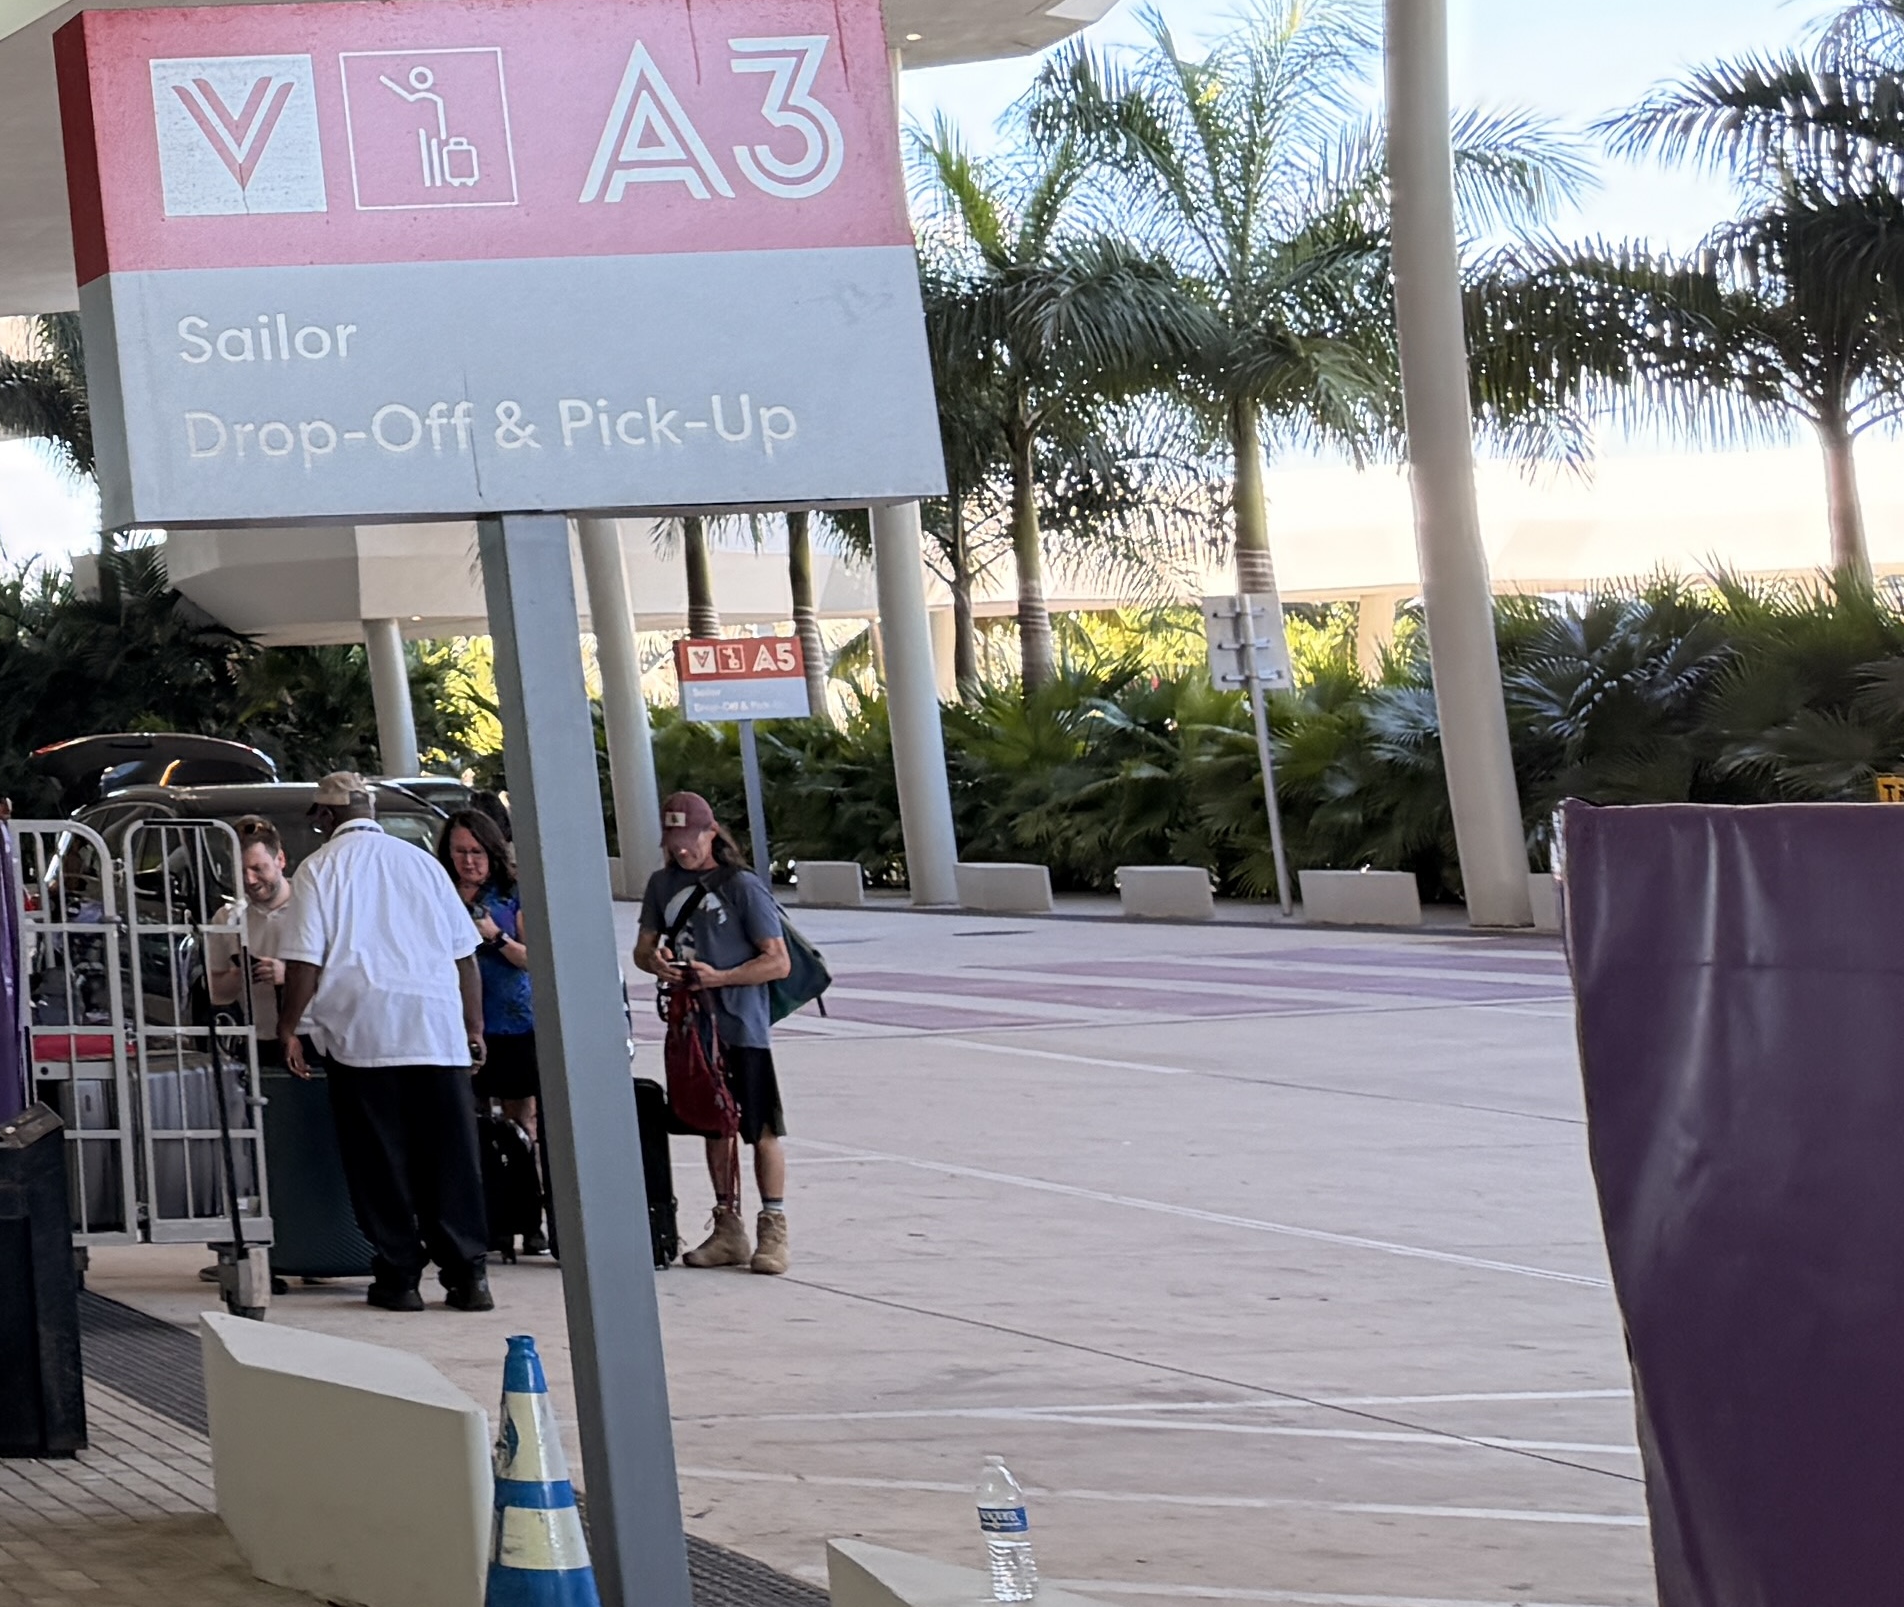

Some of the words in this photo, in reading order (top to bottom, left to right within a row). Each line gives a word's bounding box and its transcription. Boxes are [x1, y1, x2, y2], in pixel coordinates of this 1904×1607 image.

[578, 34, 845, 203] A3
[177, 312, 358, 364] Sailor
[184, 400, 474, 470] Drop-Off
[494, 399, 542, 449] &
[558, 393, 798, 459] Pick-Up
[752, 642, 796, 672] A5
